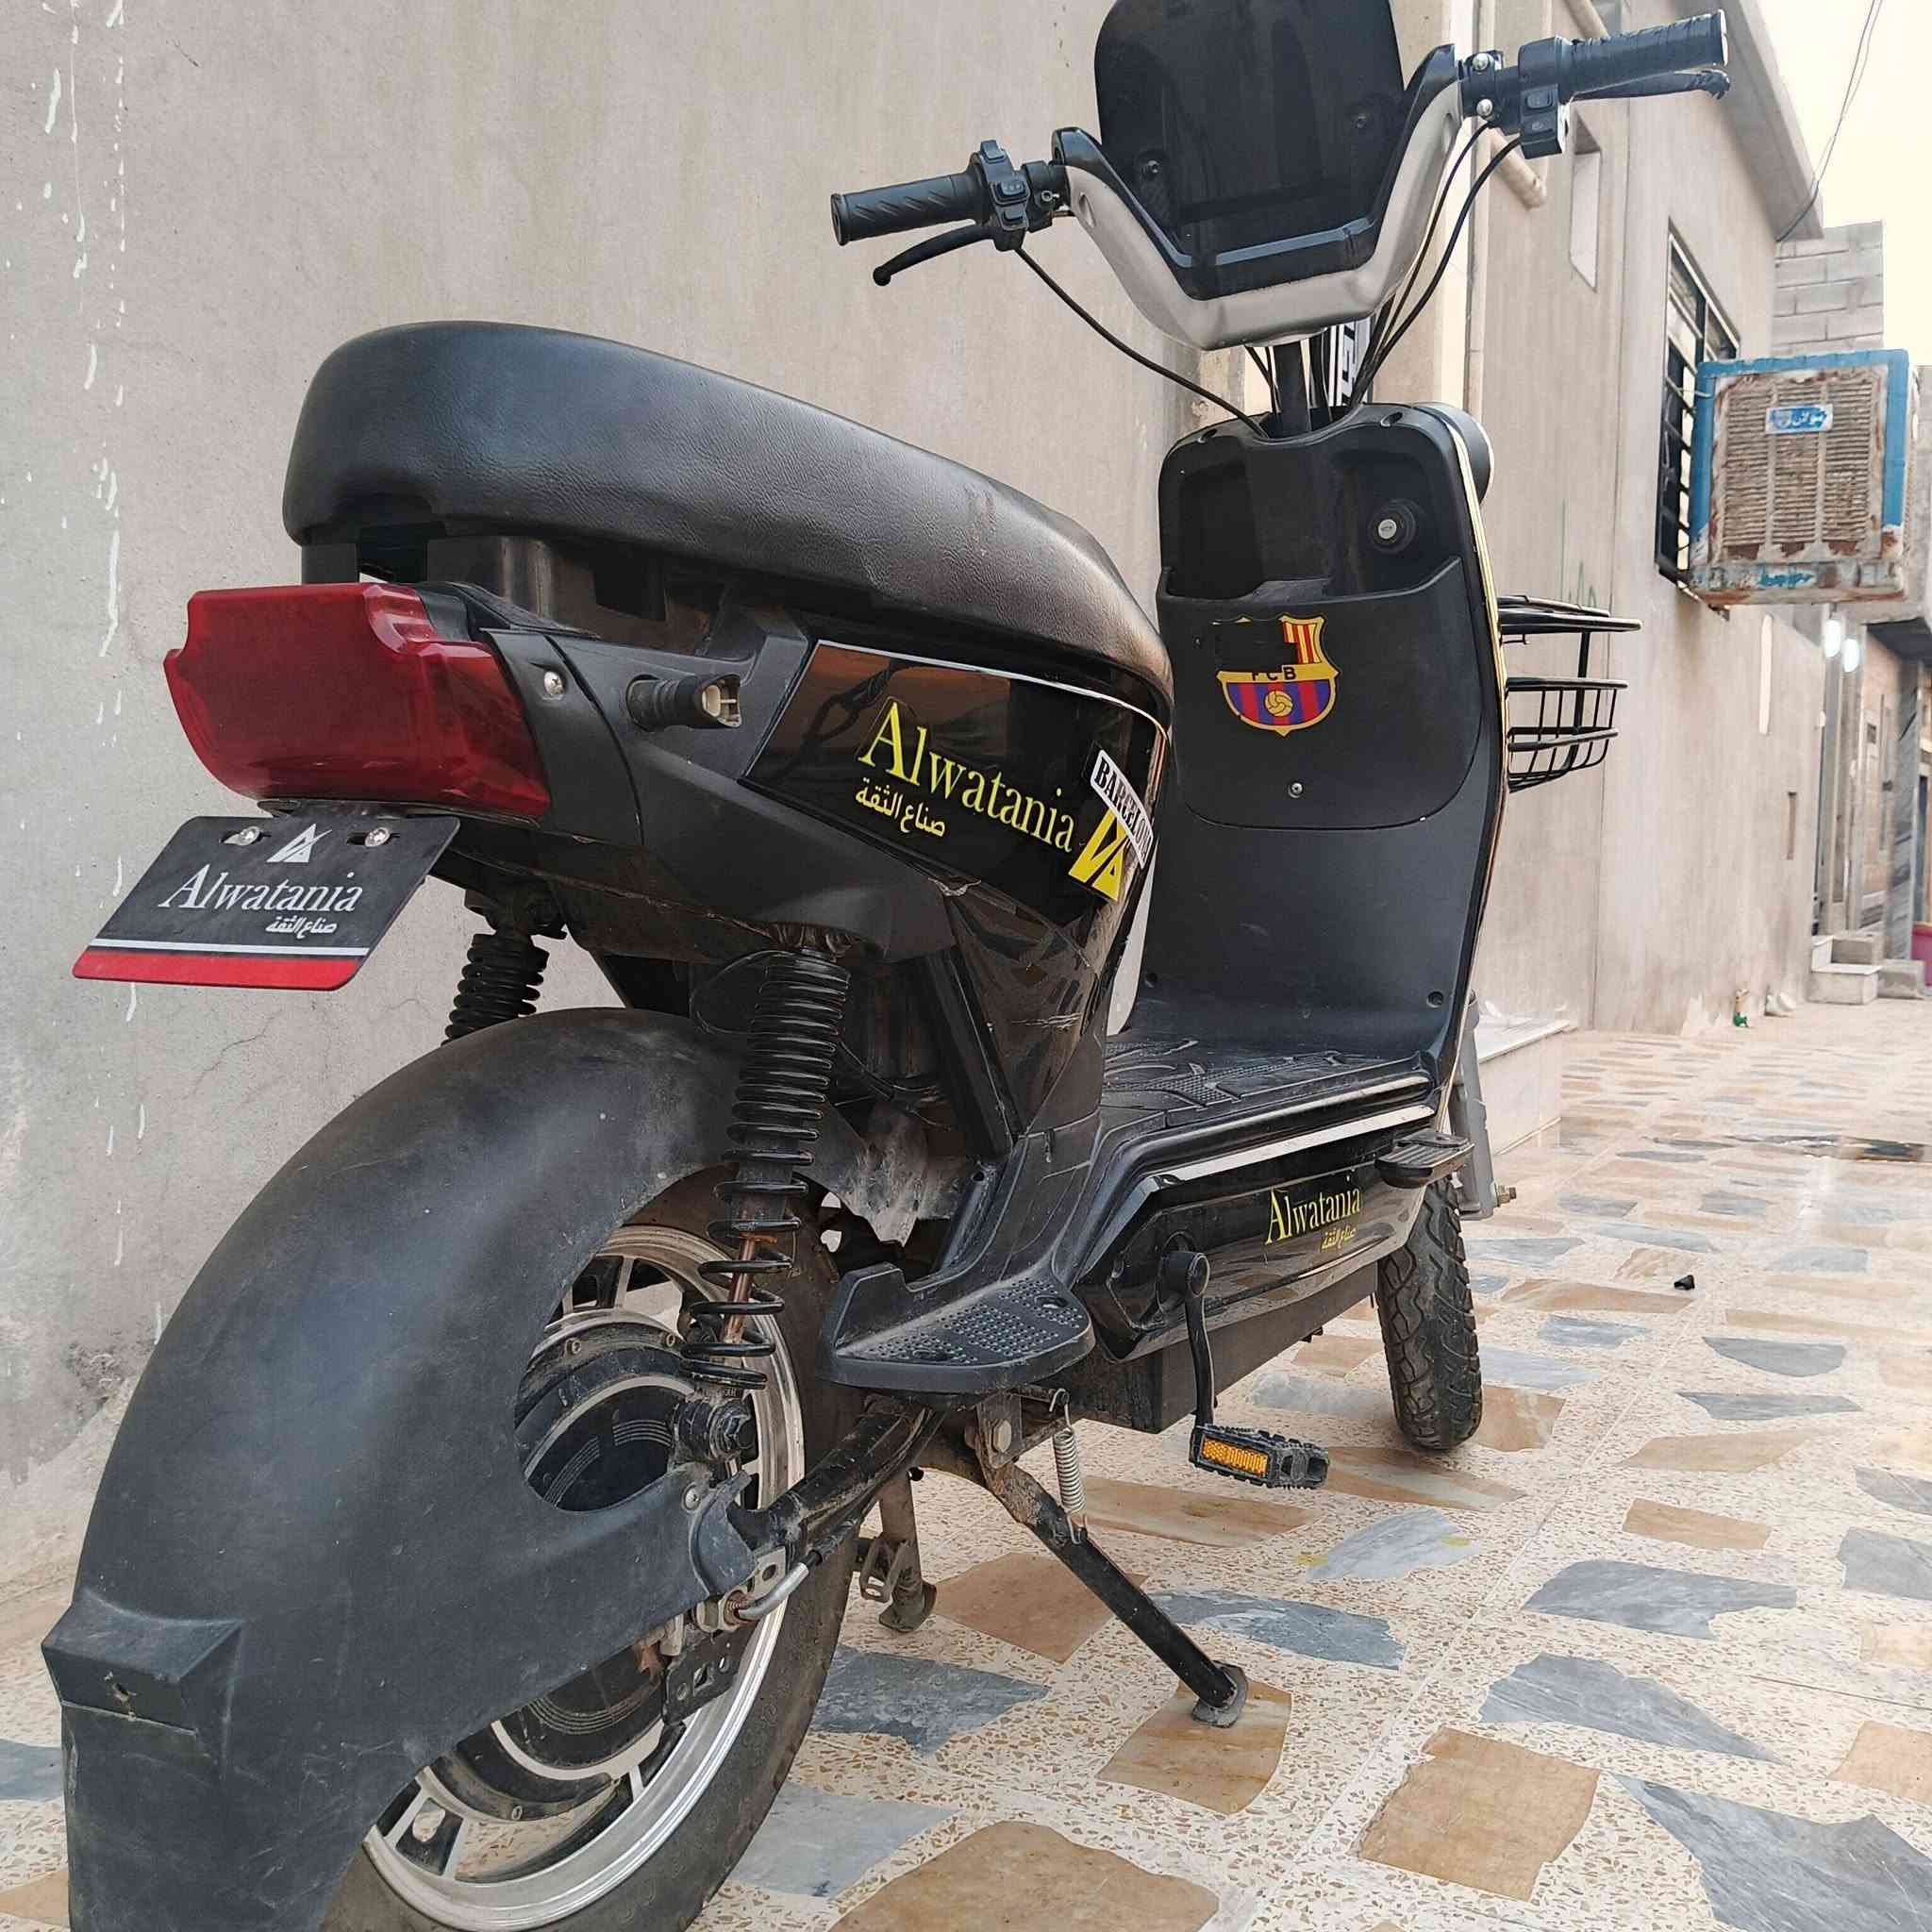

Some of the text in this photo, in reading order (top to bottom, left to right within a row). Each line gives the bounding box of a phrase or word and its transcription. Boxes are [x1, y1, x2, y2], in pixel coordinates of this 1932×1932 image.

[855, 776, 946, 838] صناع الثقة
[858, 701, 1074, 854] Alwatania
[157, 862, 364, 913] Alwatania
[264, 914, 338, 940] صناع الثقة
[1264, 1174, 1361, 1246] Alwatania
